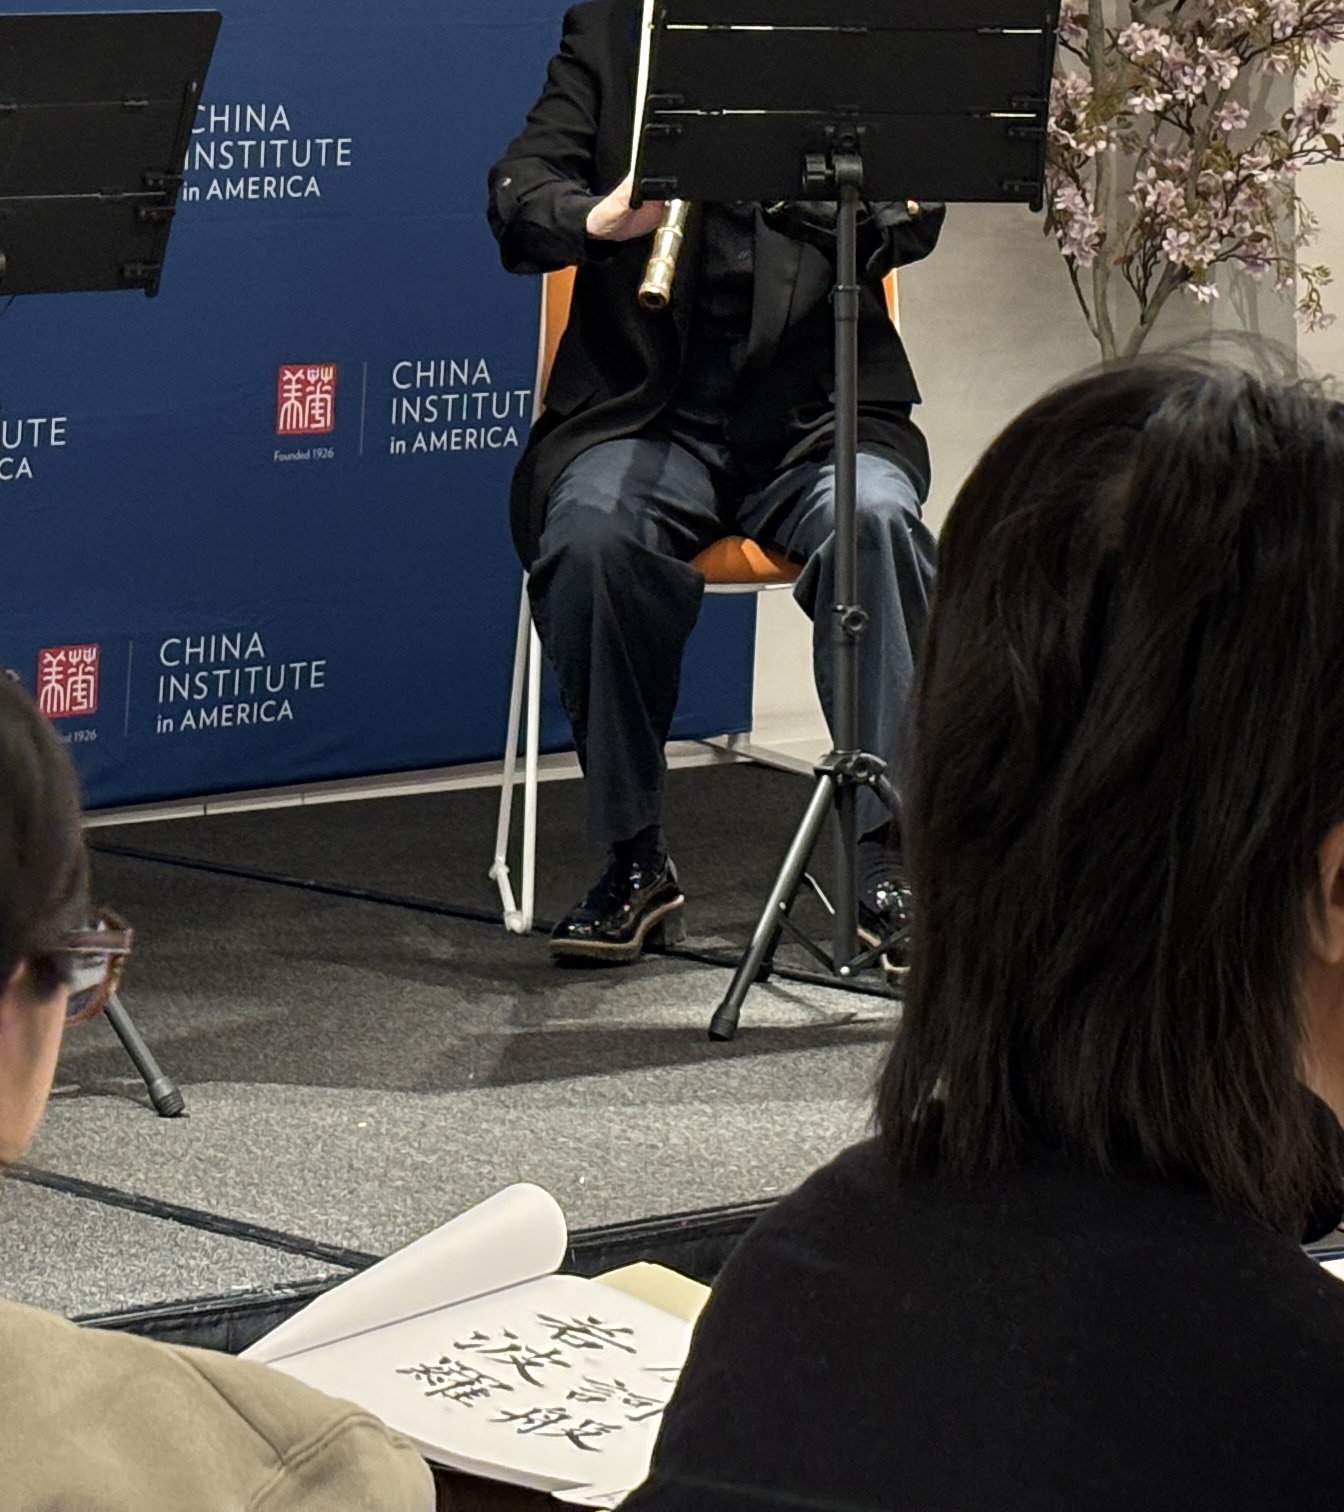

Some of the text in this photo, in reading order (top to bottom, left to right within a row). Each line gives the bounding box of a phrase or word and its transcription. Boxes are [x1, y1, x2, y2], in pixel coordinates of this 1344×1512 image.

[182, 175, 321, 202] in AMERICA
[392, 358, 491, 390] CHINA
[391, 389, 532, 425] INSTITUT
[389, 426, 519, 454] in AMERICA
[159, 631, 265, 667] CHINA
[158, 660, 326, 704] INSTITUTE
[156, 699, 294, 734] in AMERICA
[73, 729, 98, 743] 1926
